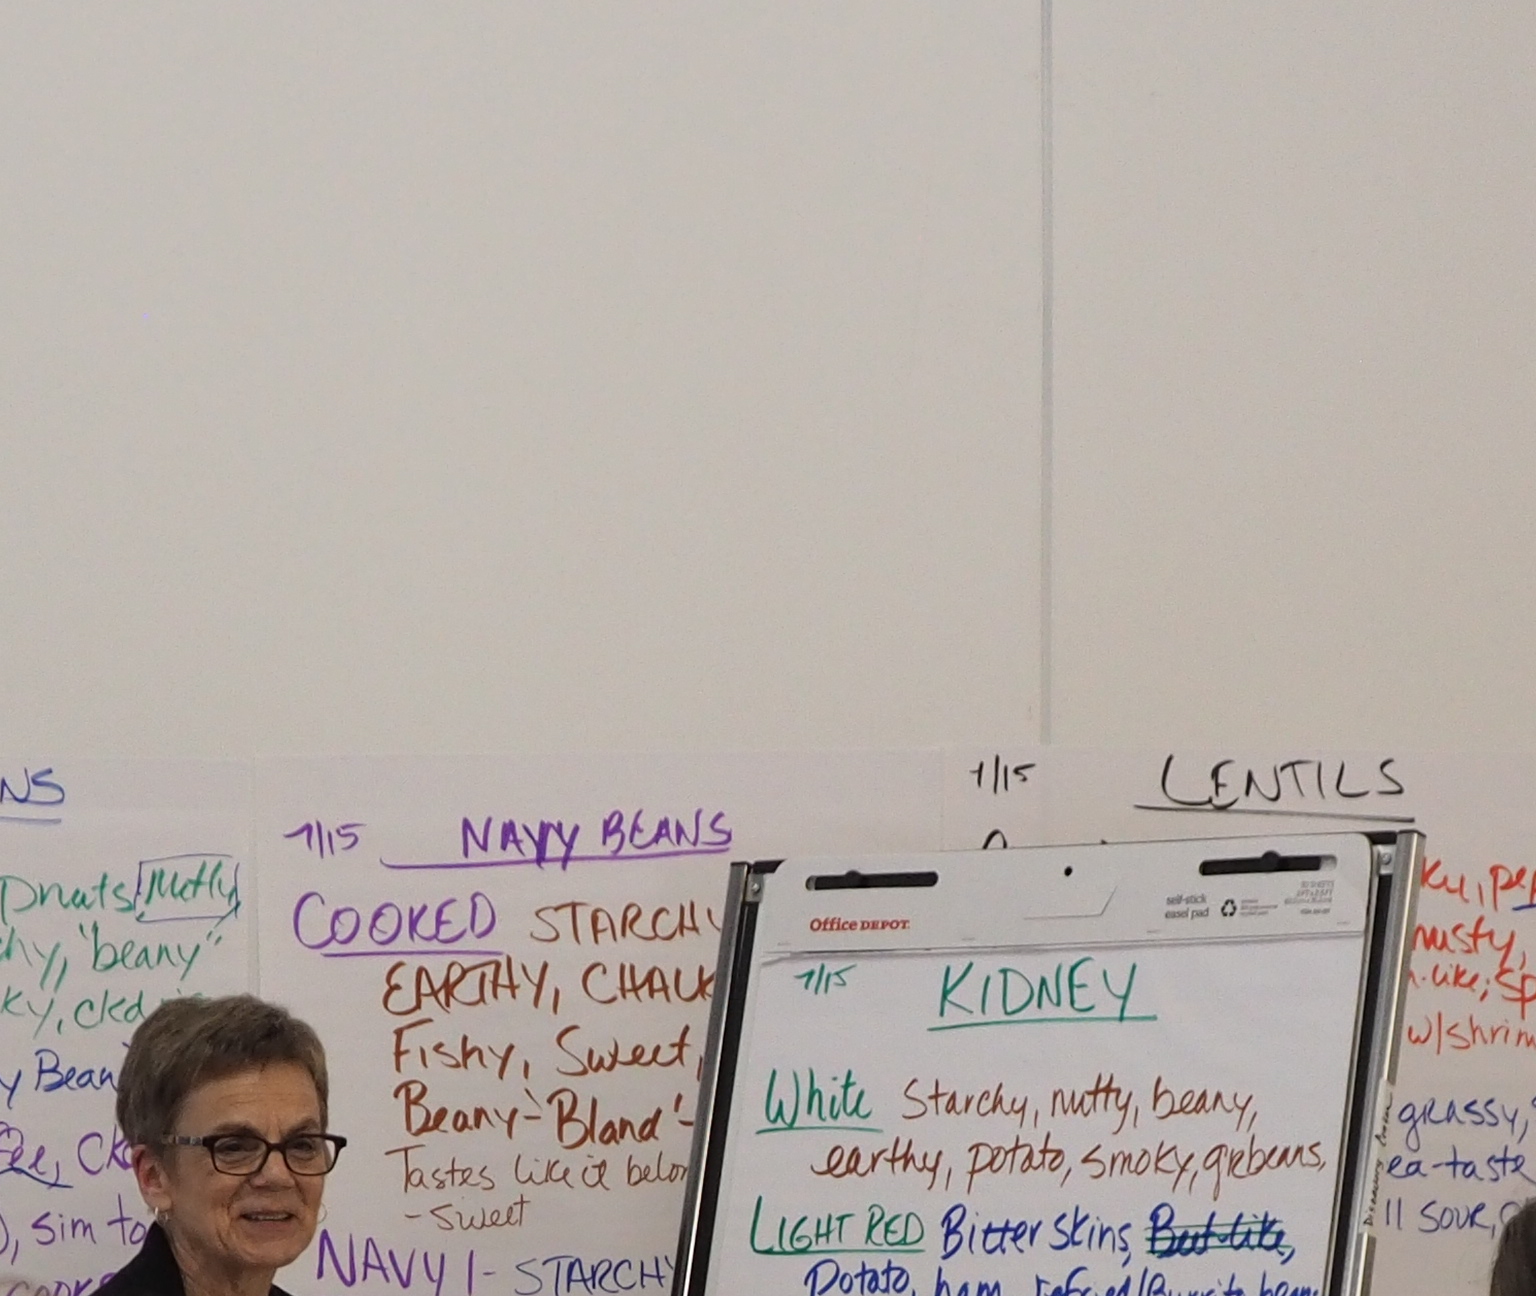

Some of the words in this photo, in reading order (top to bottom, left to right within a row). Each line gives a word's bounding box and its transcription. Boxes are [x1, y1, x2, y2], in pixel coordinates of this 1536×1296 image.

[1161, 753, 1405, 811] LENTILS
[461, 815, 581, 870] NAVY
[601, 808, 732, 855] BEANS
[292, 891, 497, 950] COOKED
[809, 917, 858, 932] Office
[1165, 906, 1189, 919] easel
[1190, 907, 1210, 920] pad
[381, 954, 561, 1017] EARTHY,
[581, 961, 716, 1005] CHALK
[937, 956, 1138, 1023] KIDNEY
[392, 1017, 532, 1080] Fishy,
[764, 1066, 874, 1129] White
[1051, 1072, 1139, 1136] nutty,
[1152, 1075, 1258, 1133] beany,
[513, 1153, 572, 1188] like
[810, 1136, 953, 1192] earthy,
[967, 1135, 1072, 1194] potato,
[750, 1195, 856, 1254] LIGHT
[864, 1203, 925, 1248] RED
[939, 1202, 1044, 1261] Bitter
